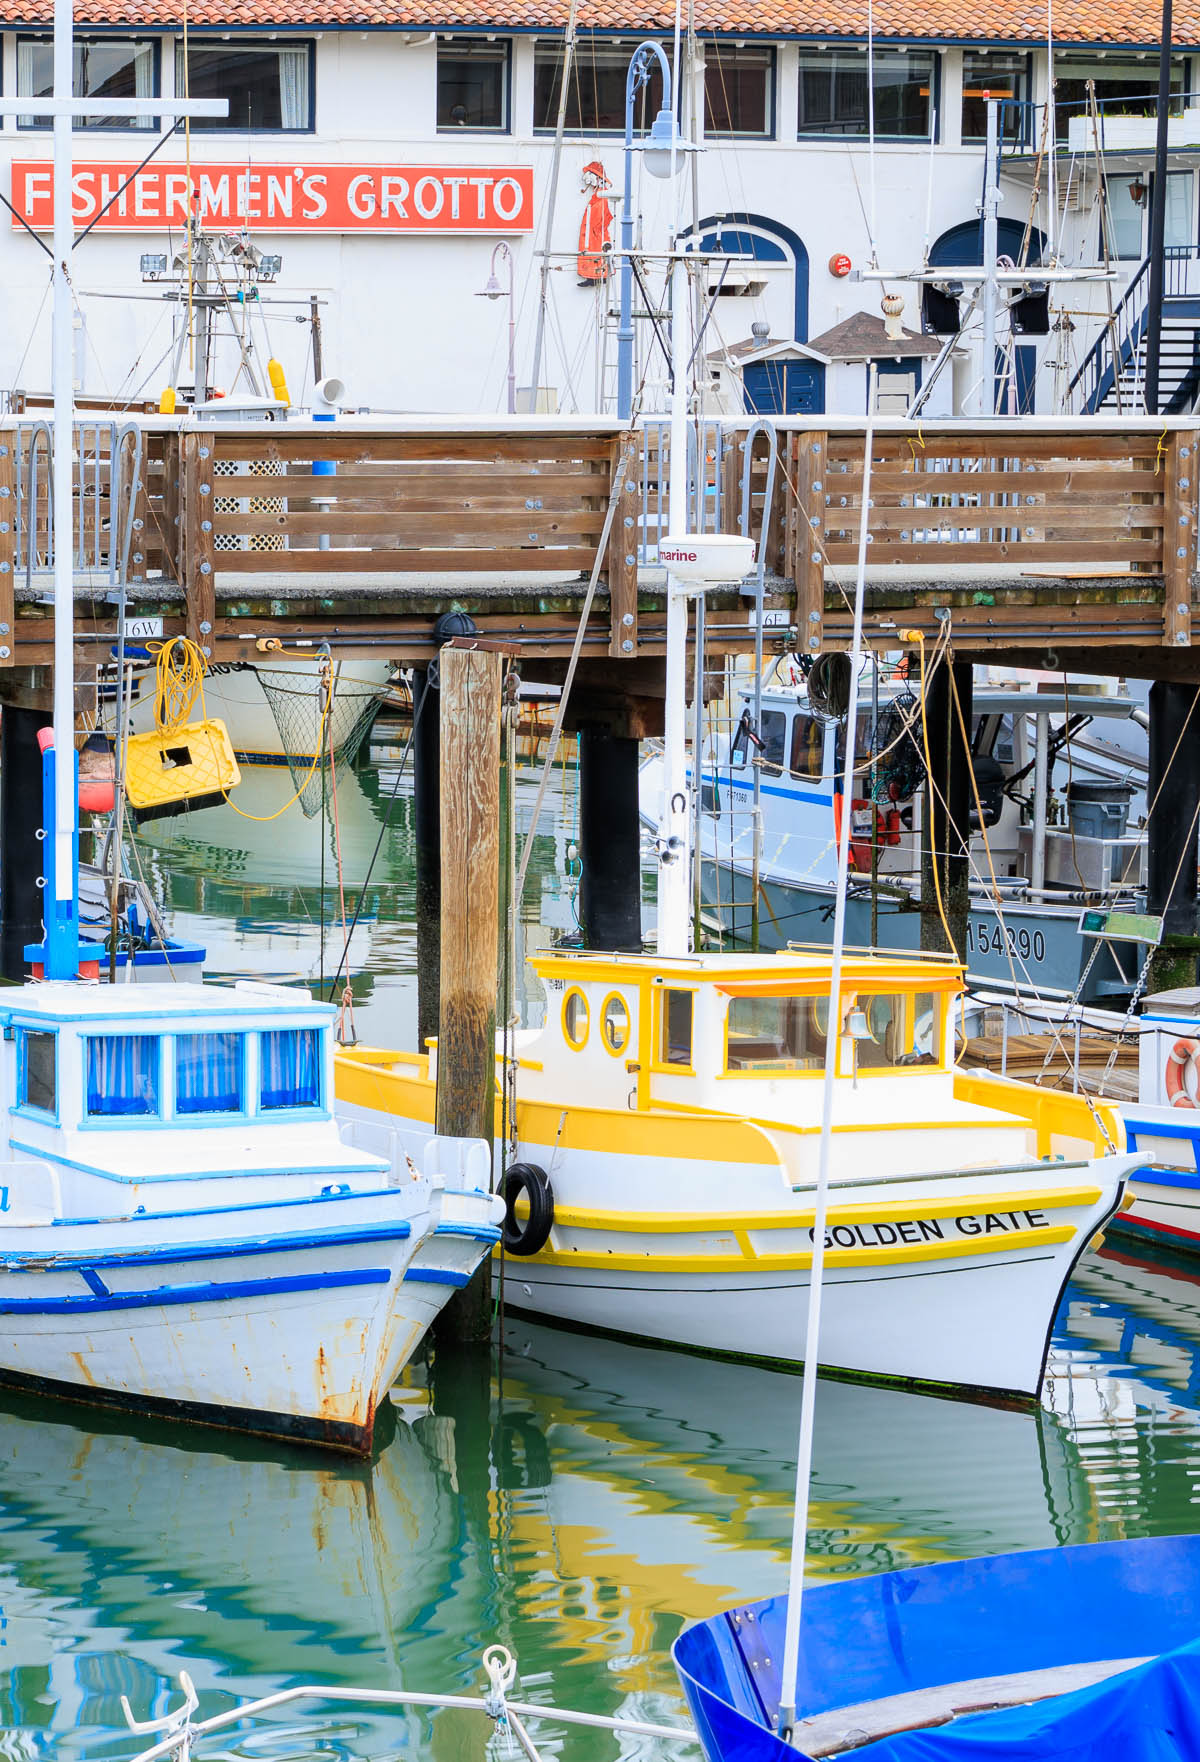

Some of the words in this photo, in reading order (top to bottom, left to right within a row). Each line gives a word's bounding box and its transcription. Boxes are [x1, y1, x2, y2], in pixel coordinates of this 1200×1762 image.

[25, 168, 327, 219] FSHERMEN'S
[347, 174, 523, 221] GROTTO
[125, 621, 158, 637] 16W
[966, 921, 1046, 963] 154290
[808, 1219, 945, 1250] GOLDEN
[955, 1208, 1050, 1236] GATE
